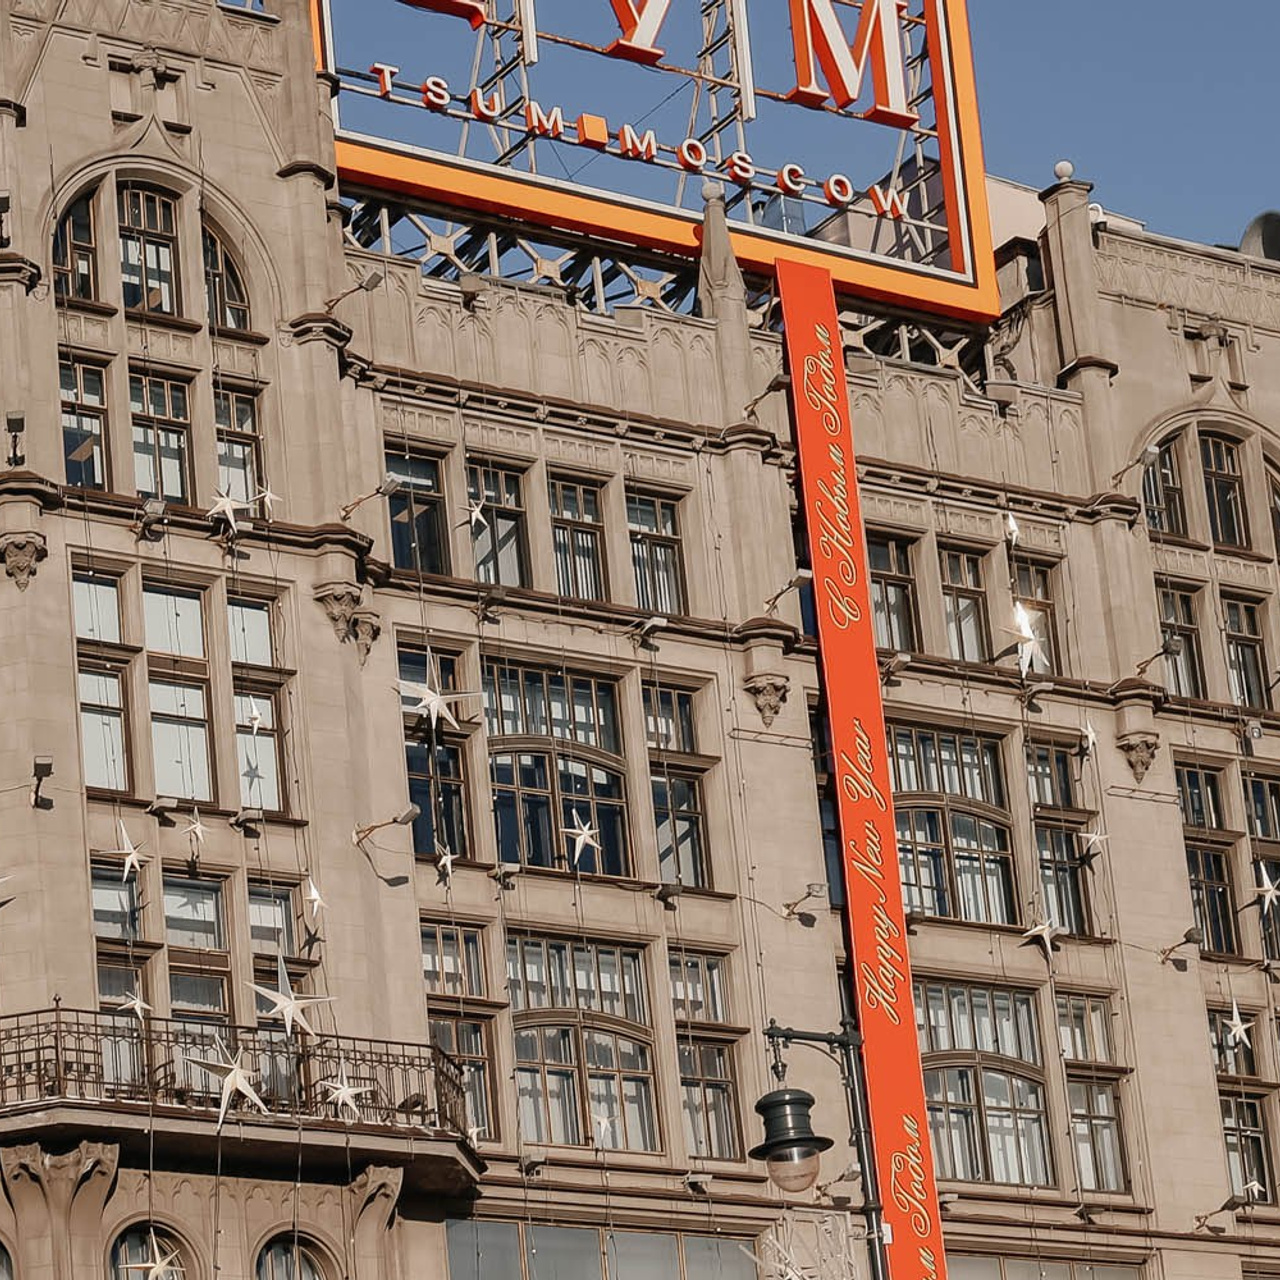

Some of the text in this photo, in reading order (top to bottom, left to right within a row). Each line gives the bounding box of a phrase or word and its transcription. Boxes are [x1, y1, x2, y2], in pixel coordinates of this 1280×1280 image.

[370, 63, 565, 138] TSUM
[620, 123, 912, 220] MOSCOW
[803, 321, 841, 436] Годом
[814, 442, 858, 588] Новым
[841, 717, 905, 1025] Happy New Year
[890, 1114, 932, 1239] Годом
